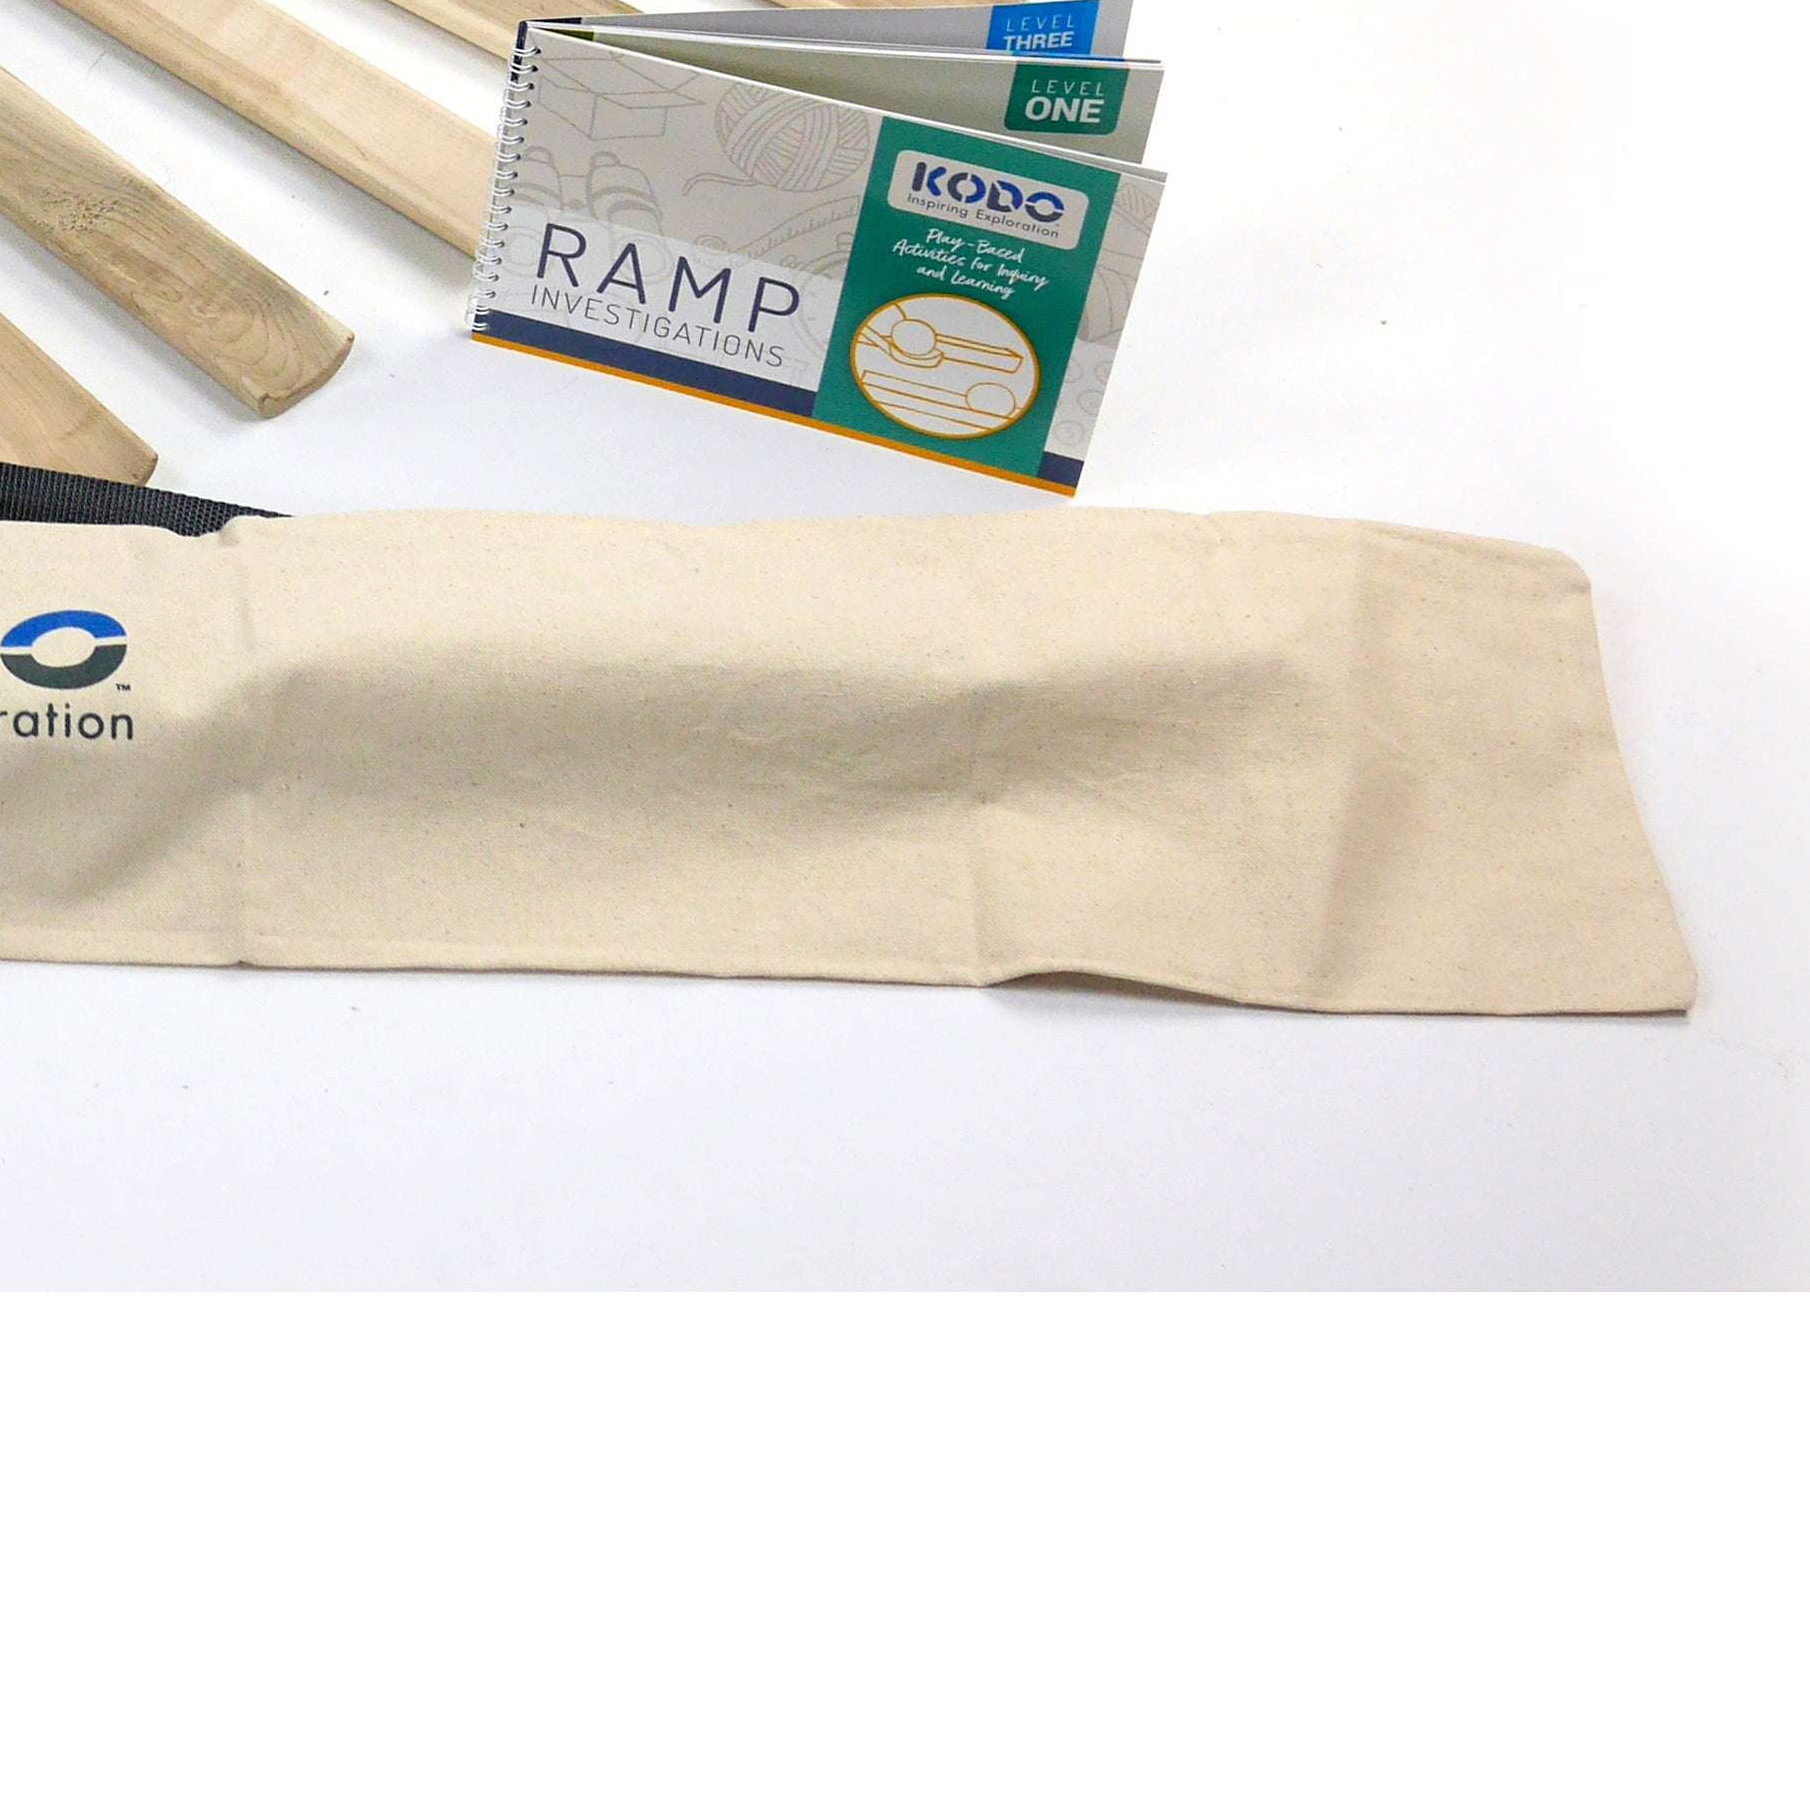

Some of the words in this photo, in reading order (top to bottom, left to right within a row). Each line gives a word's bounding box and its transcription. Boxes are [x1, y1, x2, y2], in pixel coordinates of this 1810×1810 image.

[1003, 31, 1075, 53] THREE
[1006, 14, 1076, 32] LEVEL
[1031, 79, 1104, 97] LEVEL
[1024, 96, 1105, 124] ONE
[911, 161, 1065, 223] KODO
[907, 193, 969, 218] Inspiring
[975, 209, 1059, 239] Exploration
[536, 223, 800, 333] RAMP
[893, 238, 966, 266] Activities
[970, 257, 992, 272] for
[997, 263, 1050, 291] Inquiry
[917, 265, 947, 281] and
[950, 270, 1014, 300] Learning
[531, 284, 785, 368] INVESTIGATIONS
